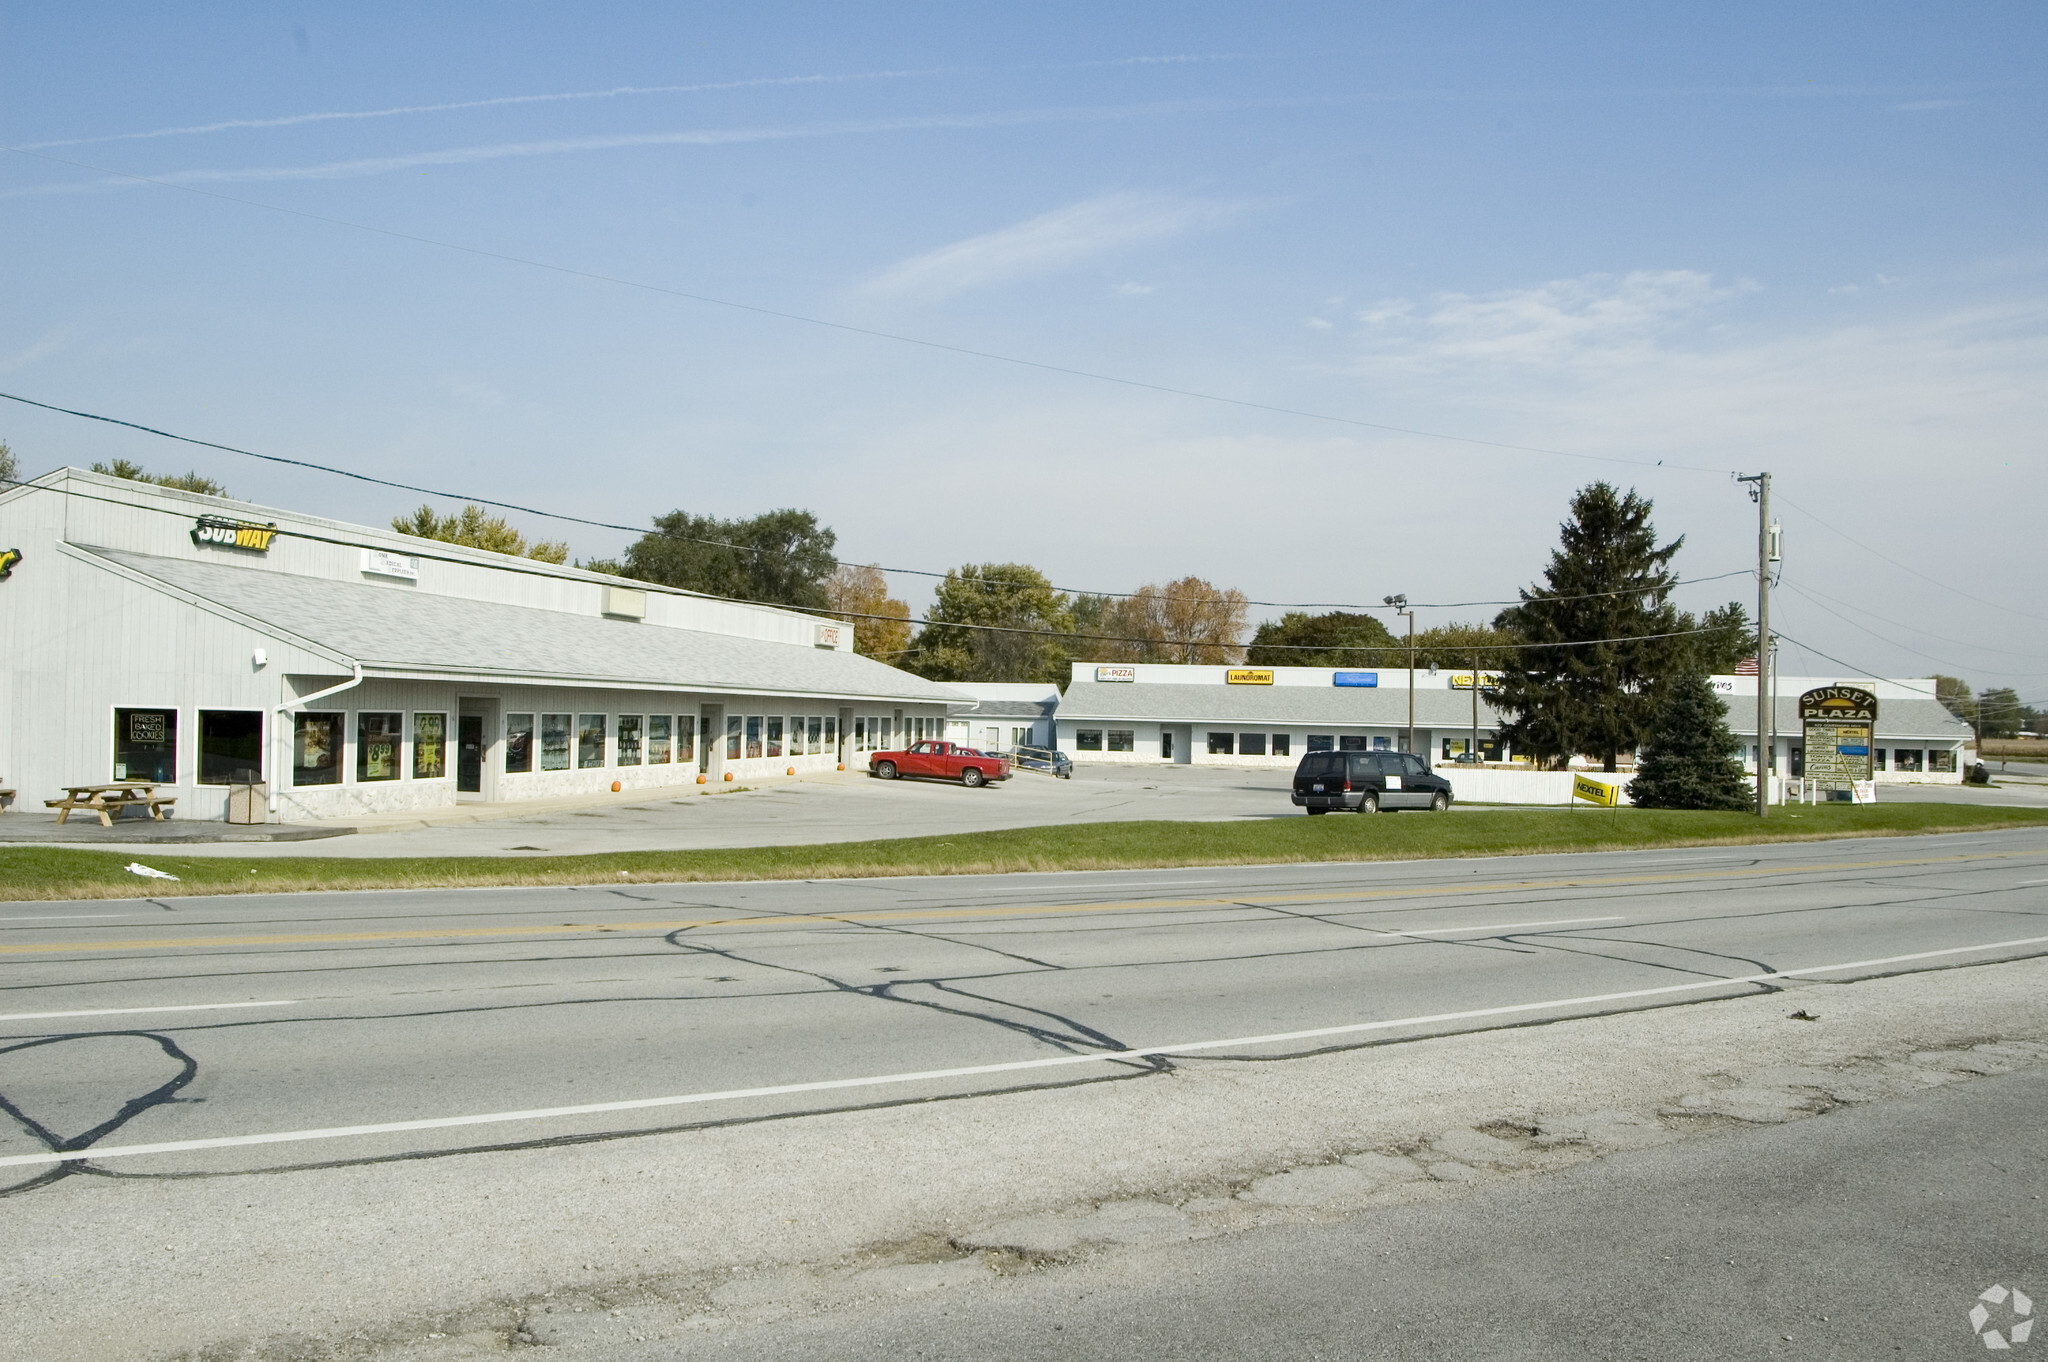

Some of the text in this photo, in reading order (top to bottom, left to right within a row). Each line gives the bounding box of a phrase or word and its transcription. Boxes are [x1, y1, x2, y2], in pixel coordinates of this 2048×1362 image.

[198, 516, 276, 549] SUBWAY
[1111, 669, 1133, 677] PIZZA
[1802, 688, 1875, 706] SUNSET
[1804, 709, 1872, 718] PLAZA
[134, 715, 161, 723] FRESH
[134, 723, 161, 731] BAKED
[132, 731, 163, 740] COOKIES
[1577, 782, 1606, 797] NEXTEL
